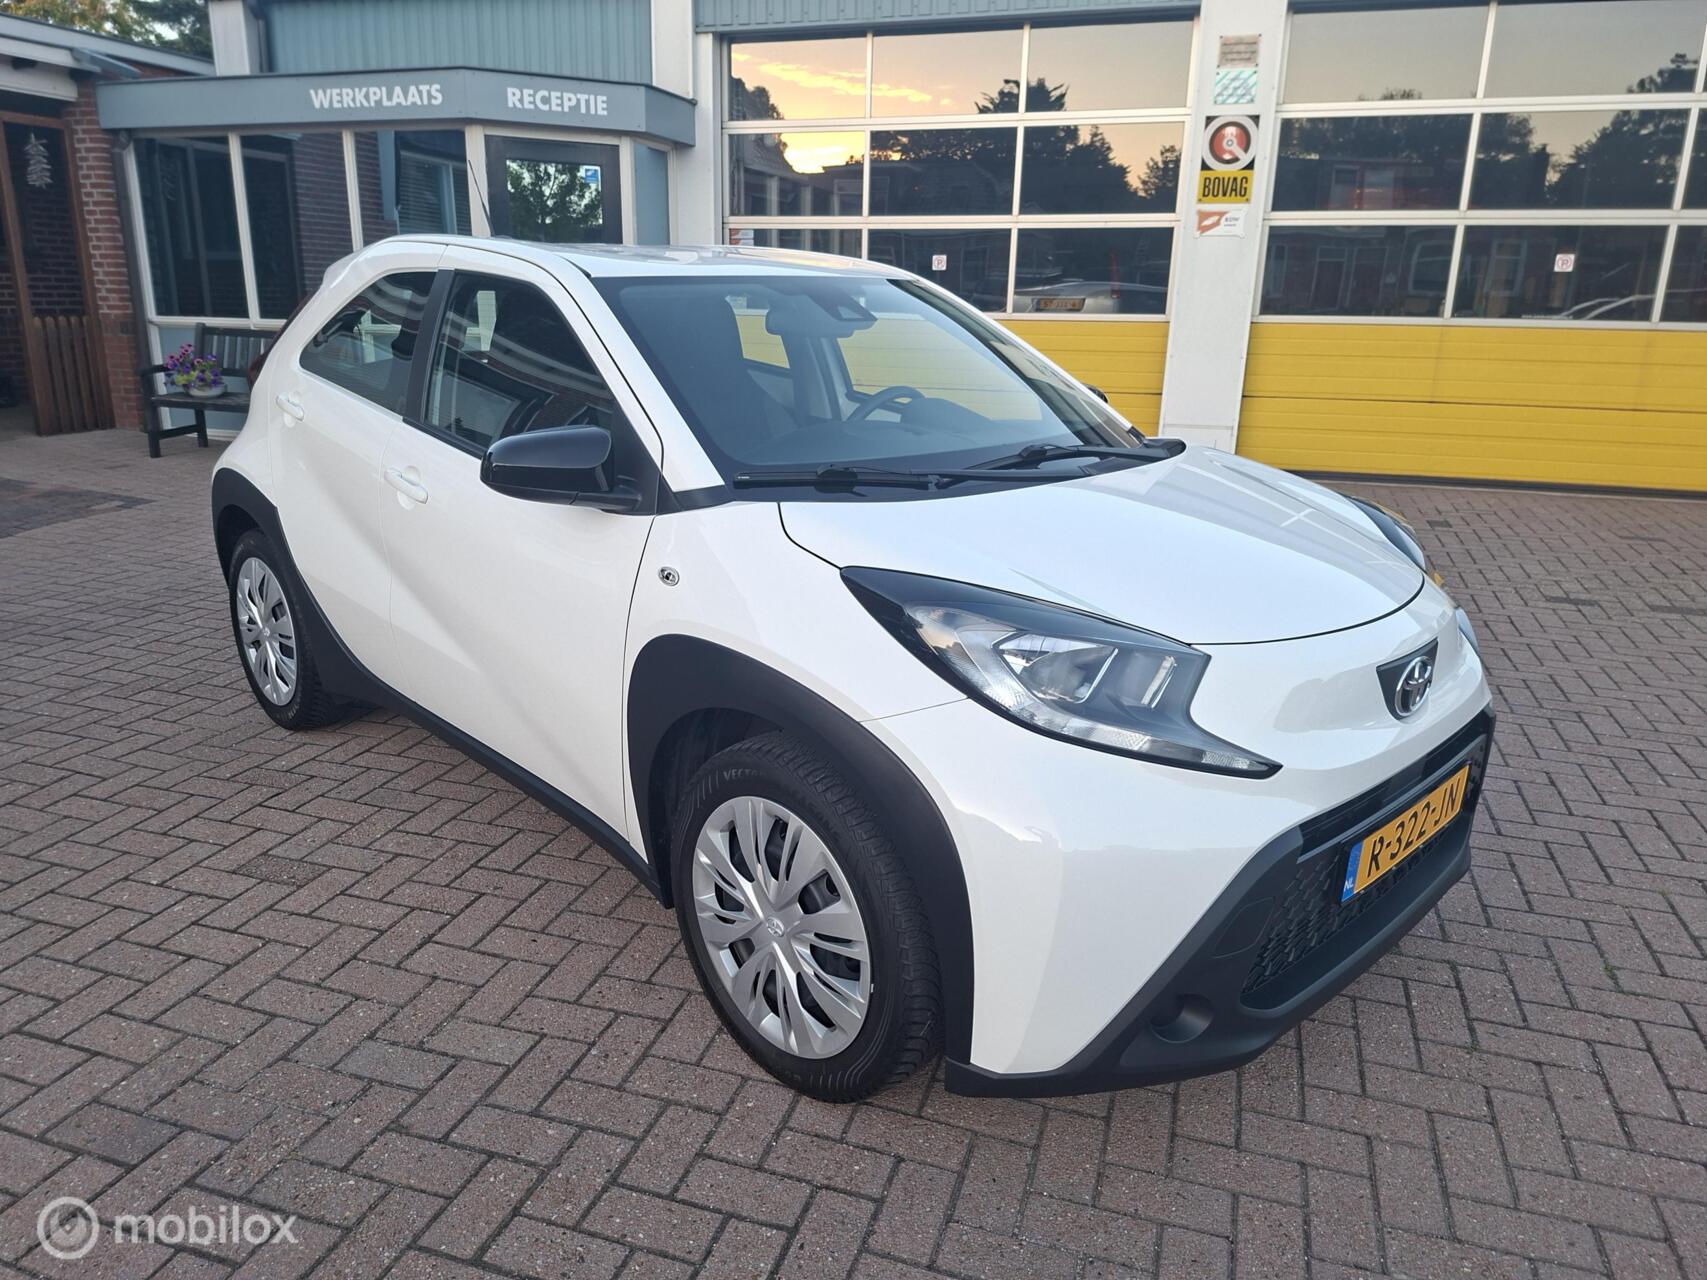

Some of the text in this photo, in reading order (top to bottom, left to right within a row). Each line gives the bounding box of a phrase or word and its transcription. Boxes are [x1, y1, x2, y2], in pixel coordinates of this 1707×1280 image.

[309, 84, 443, 109] WERKPLAATS
[506, 87, 608, 115] RECEPTIE
[1202, 176, 1248, 198] BOVAG
[1367, 778, 1460, 877] R-322-JN
[1343, 879, 1354, 892] NL
